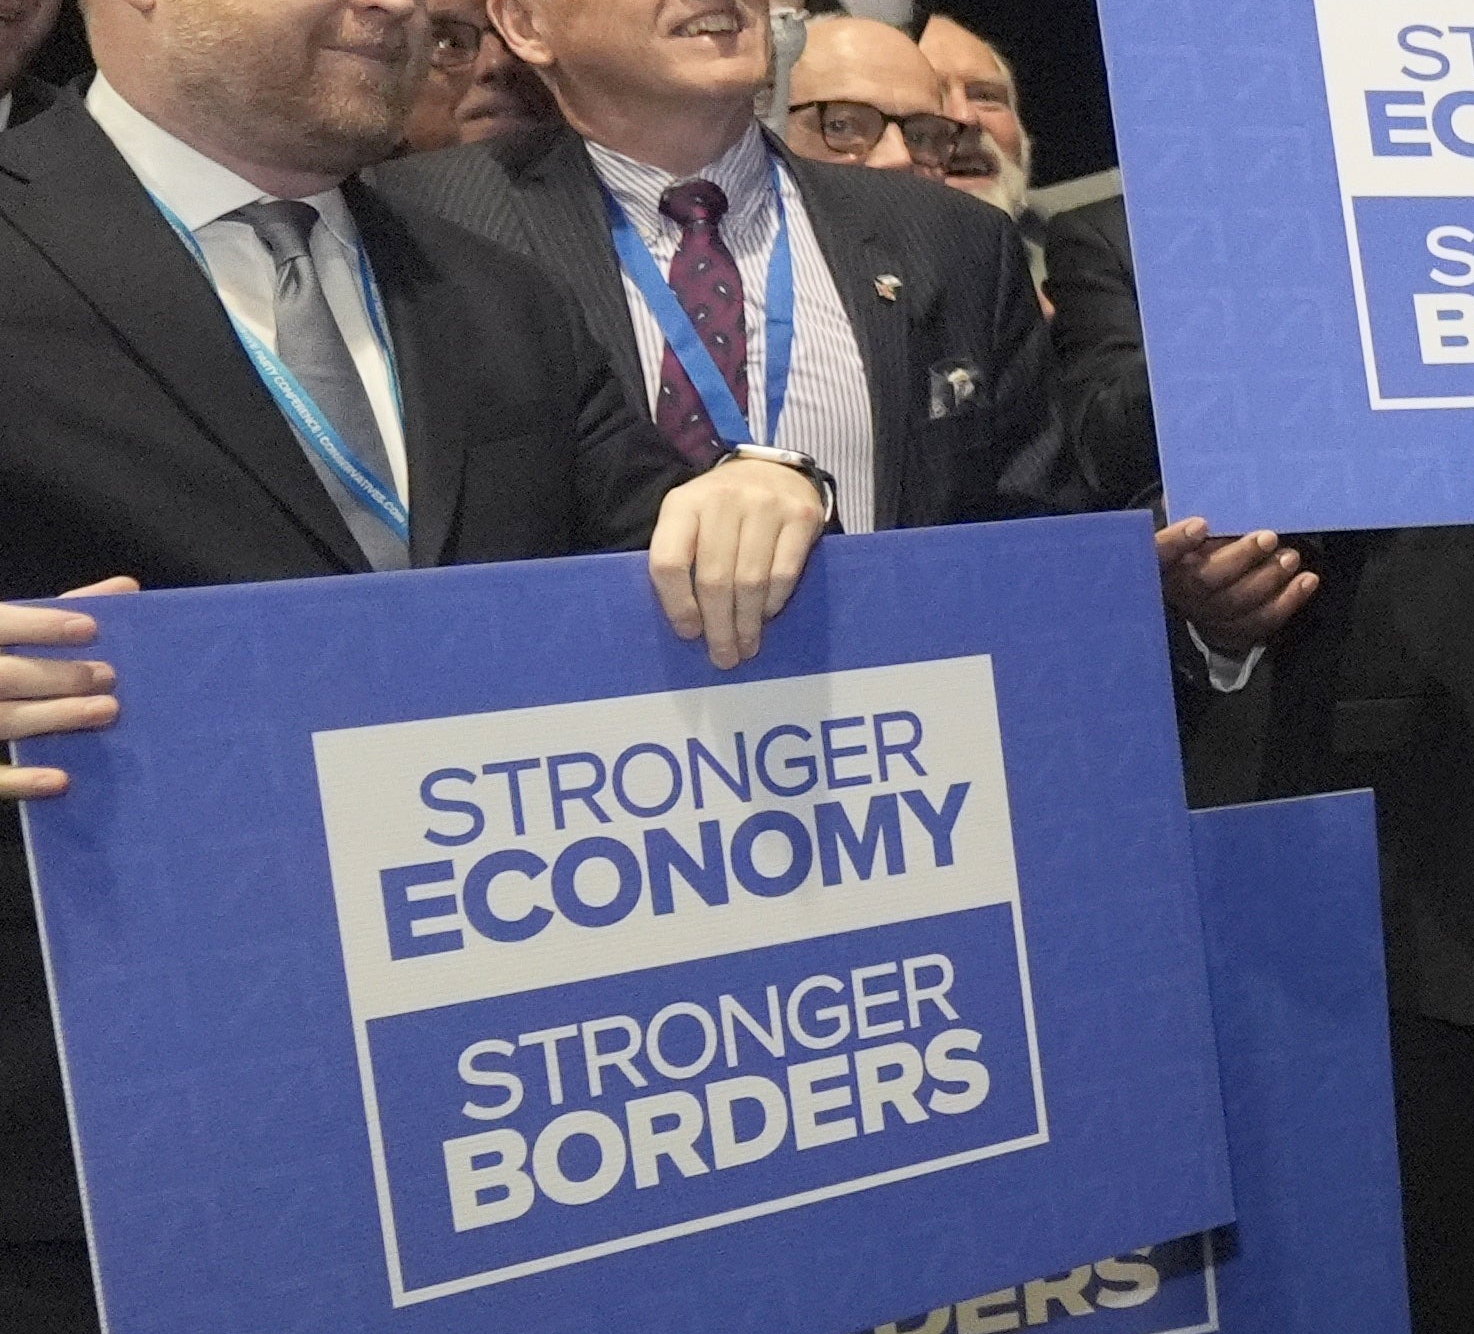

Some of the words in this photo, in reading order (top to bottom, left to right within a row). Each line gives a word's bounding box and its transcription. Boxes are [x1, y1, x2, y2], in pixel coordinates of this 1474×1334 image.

[273, 375, 321, 434] CONFERENCE
[419, 709, 929, 847] STRONGER
[379, 781, 972, 962] ECONOMY
[456, 953, 961, 1120] STRONGER
[442, 1027, 991, 1233] BORDERS
